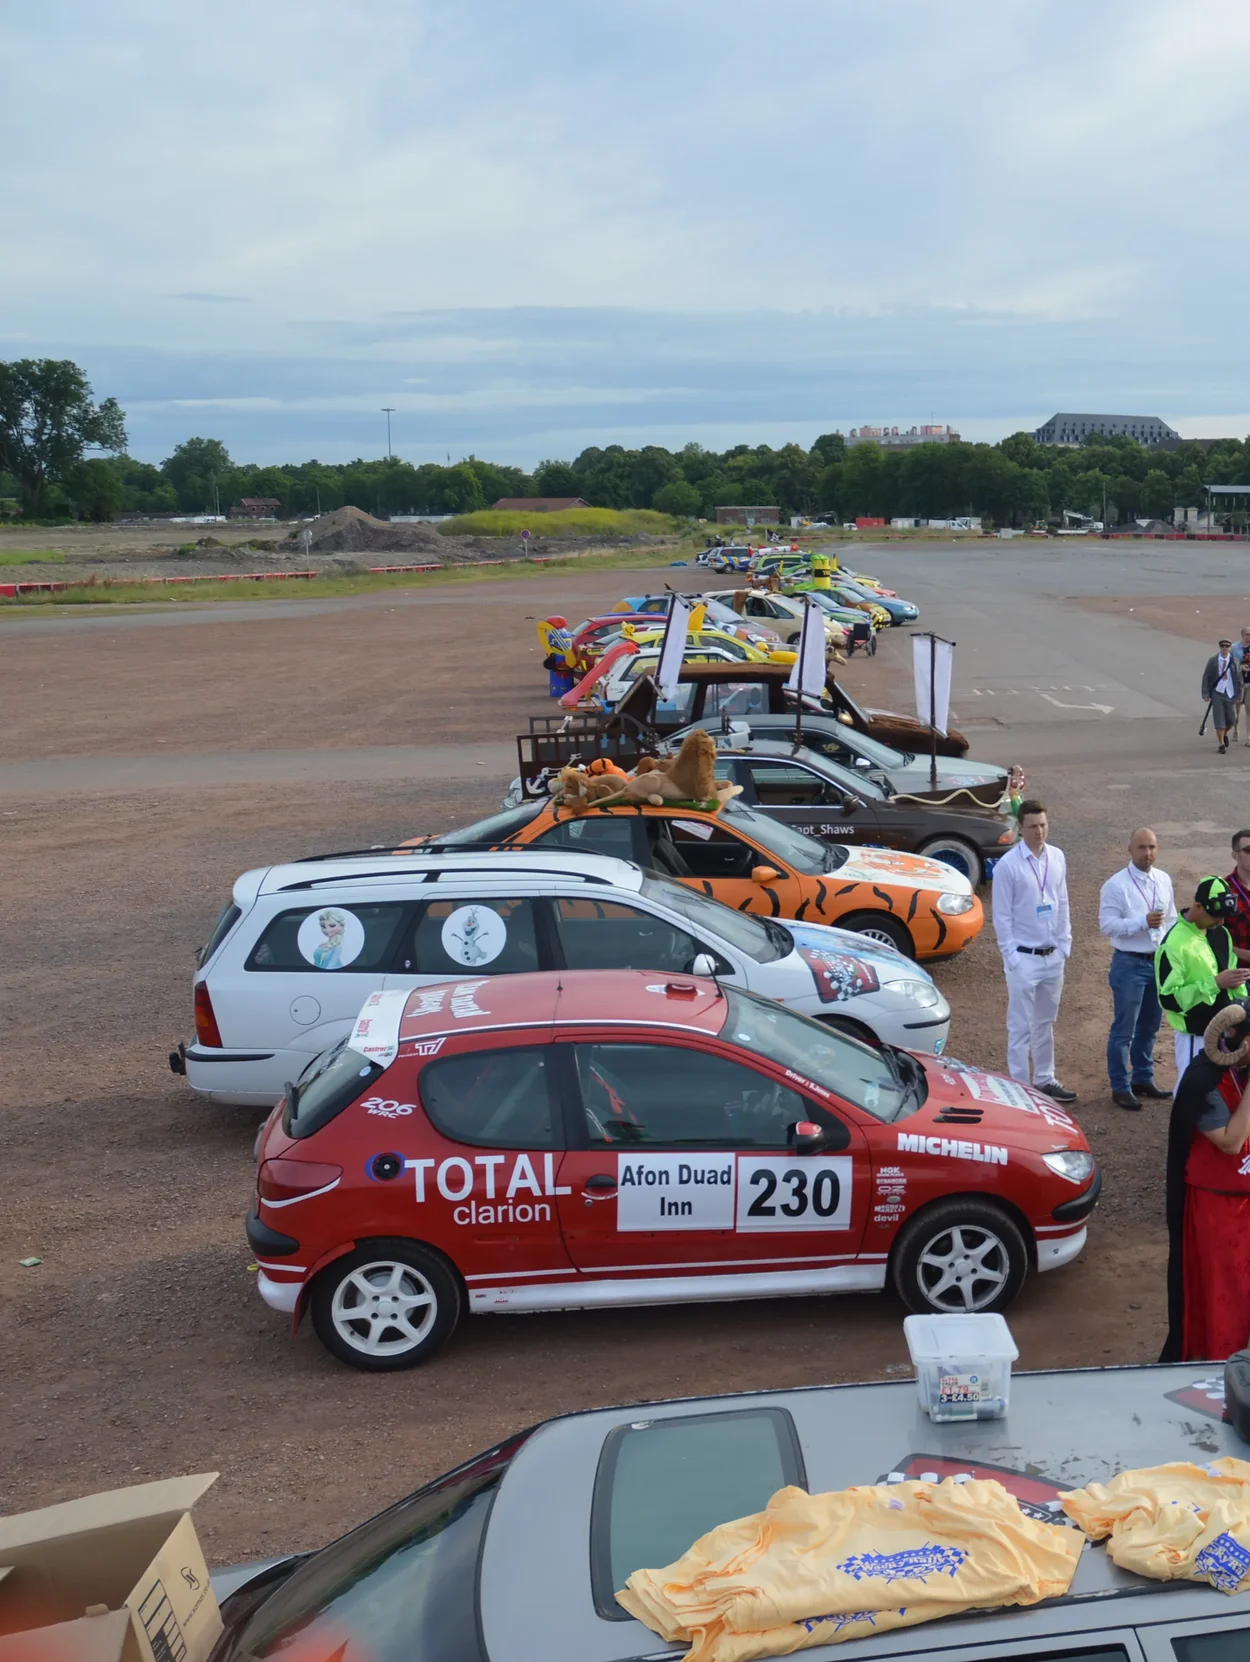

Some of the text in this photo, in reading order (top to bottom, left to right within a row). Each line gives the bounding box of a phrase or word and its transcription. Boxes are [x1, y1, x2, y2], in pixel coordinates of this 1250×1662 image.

[791, 824, 855, 837] apt_Shaws
[785, 1069, 806, 1083] Driver
[360, 1097, 417, 1116] 206
[367, 1108, 399, 1119] WRC
[897, 1132, 1009, 1166] MICHELIN
[404, 1153, 572, 1204] TOTAL
[621, 1163, 732, 1187] Afon Duad
[747, 1168, 841, 1218] 230
[453, 1198, 551, 1226] clarion
[659, 1196, 692, 1217] Inn
[873, 1213, 899, 1222] devil
[860, 1553, 947, 1572] Wacky Rally
